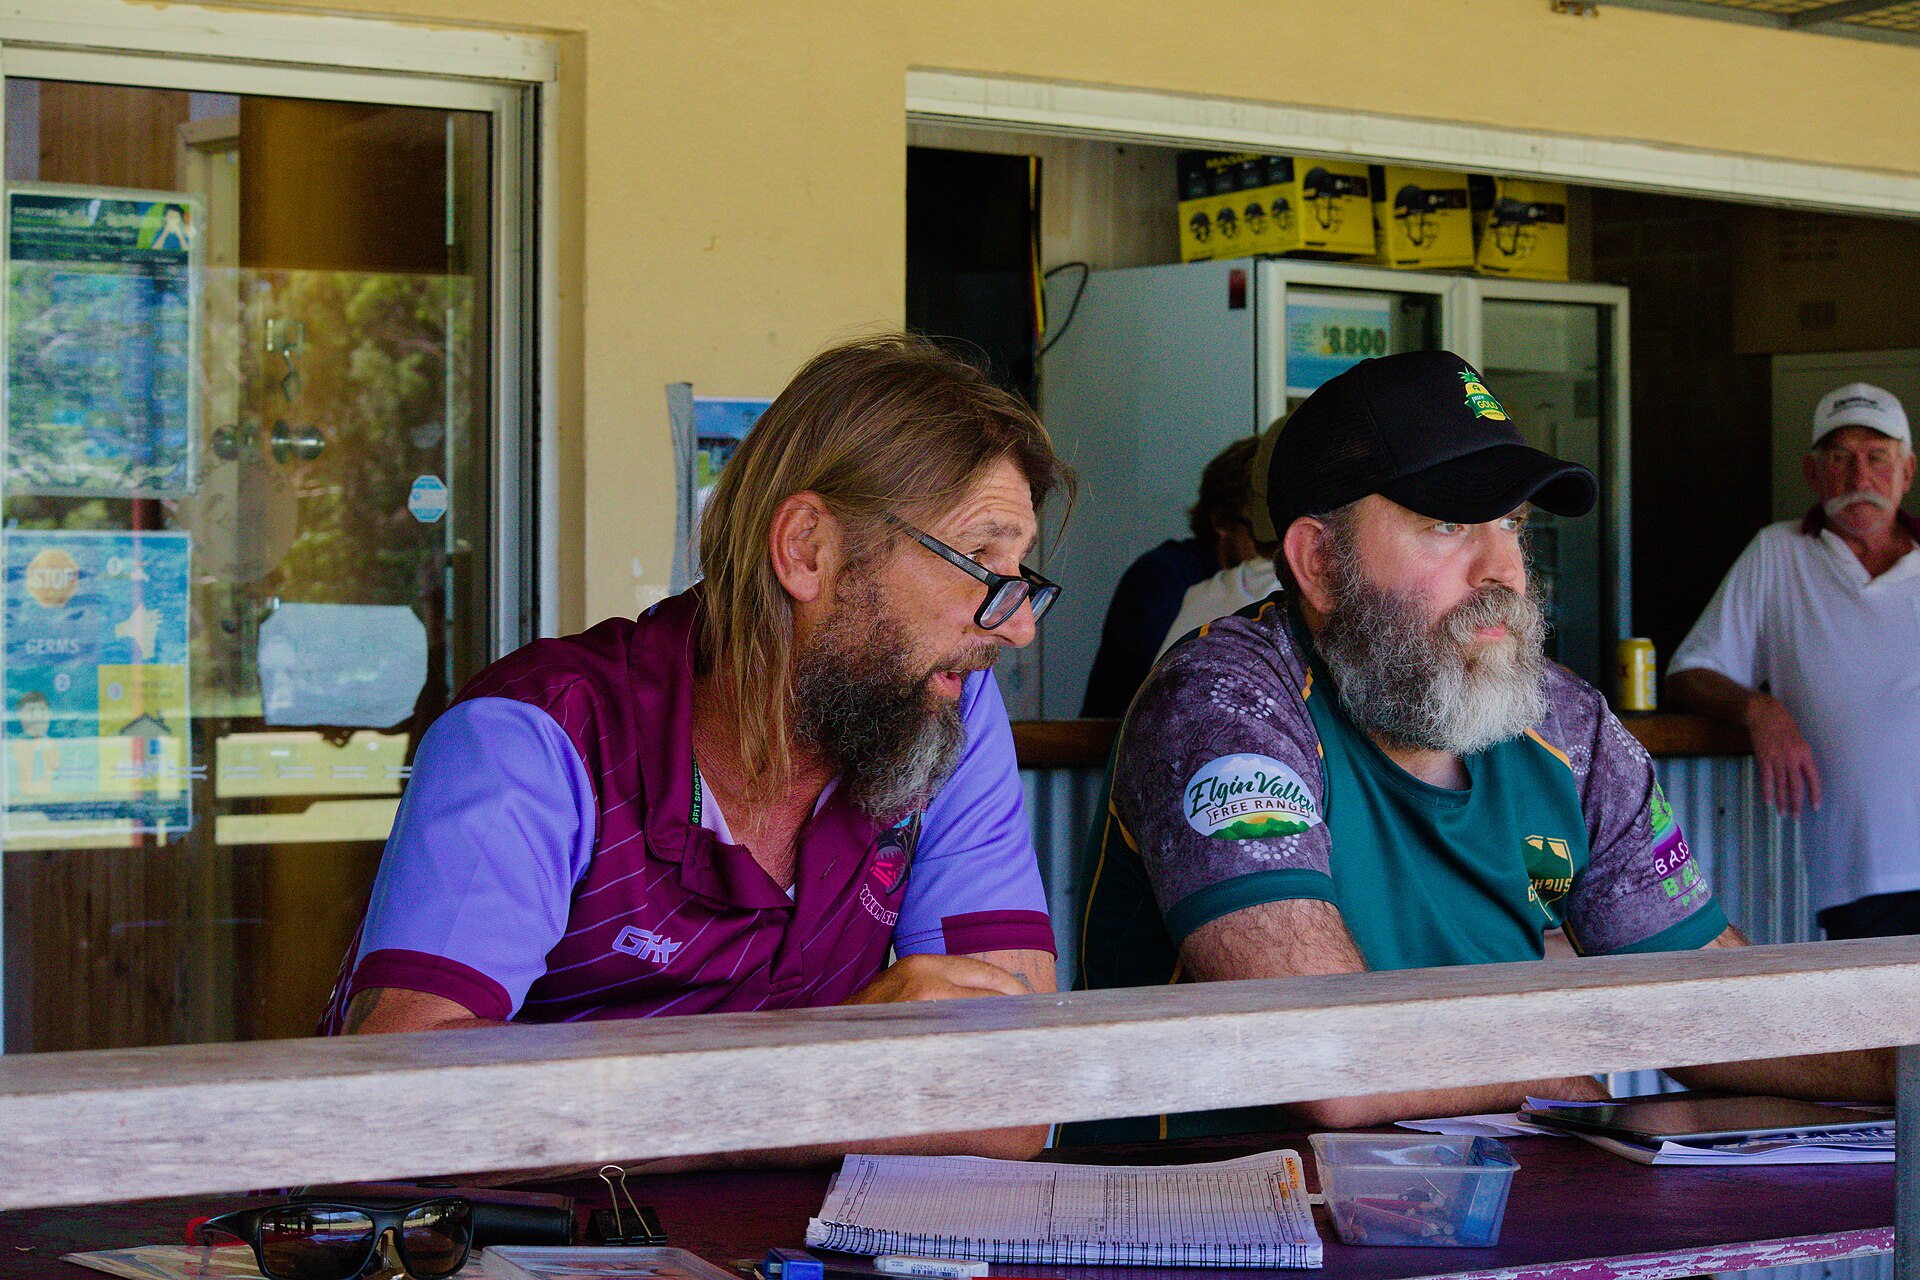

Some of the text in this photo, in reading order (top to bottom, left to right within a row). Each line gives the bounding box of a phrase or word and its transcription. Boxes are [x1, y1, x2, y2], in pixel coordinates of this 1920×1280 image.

[31, 567, 74, 590] STOP
[1188, 775, 1256, 820] Elgin
[1212, 801, 1249, 821] FREE
